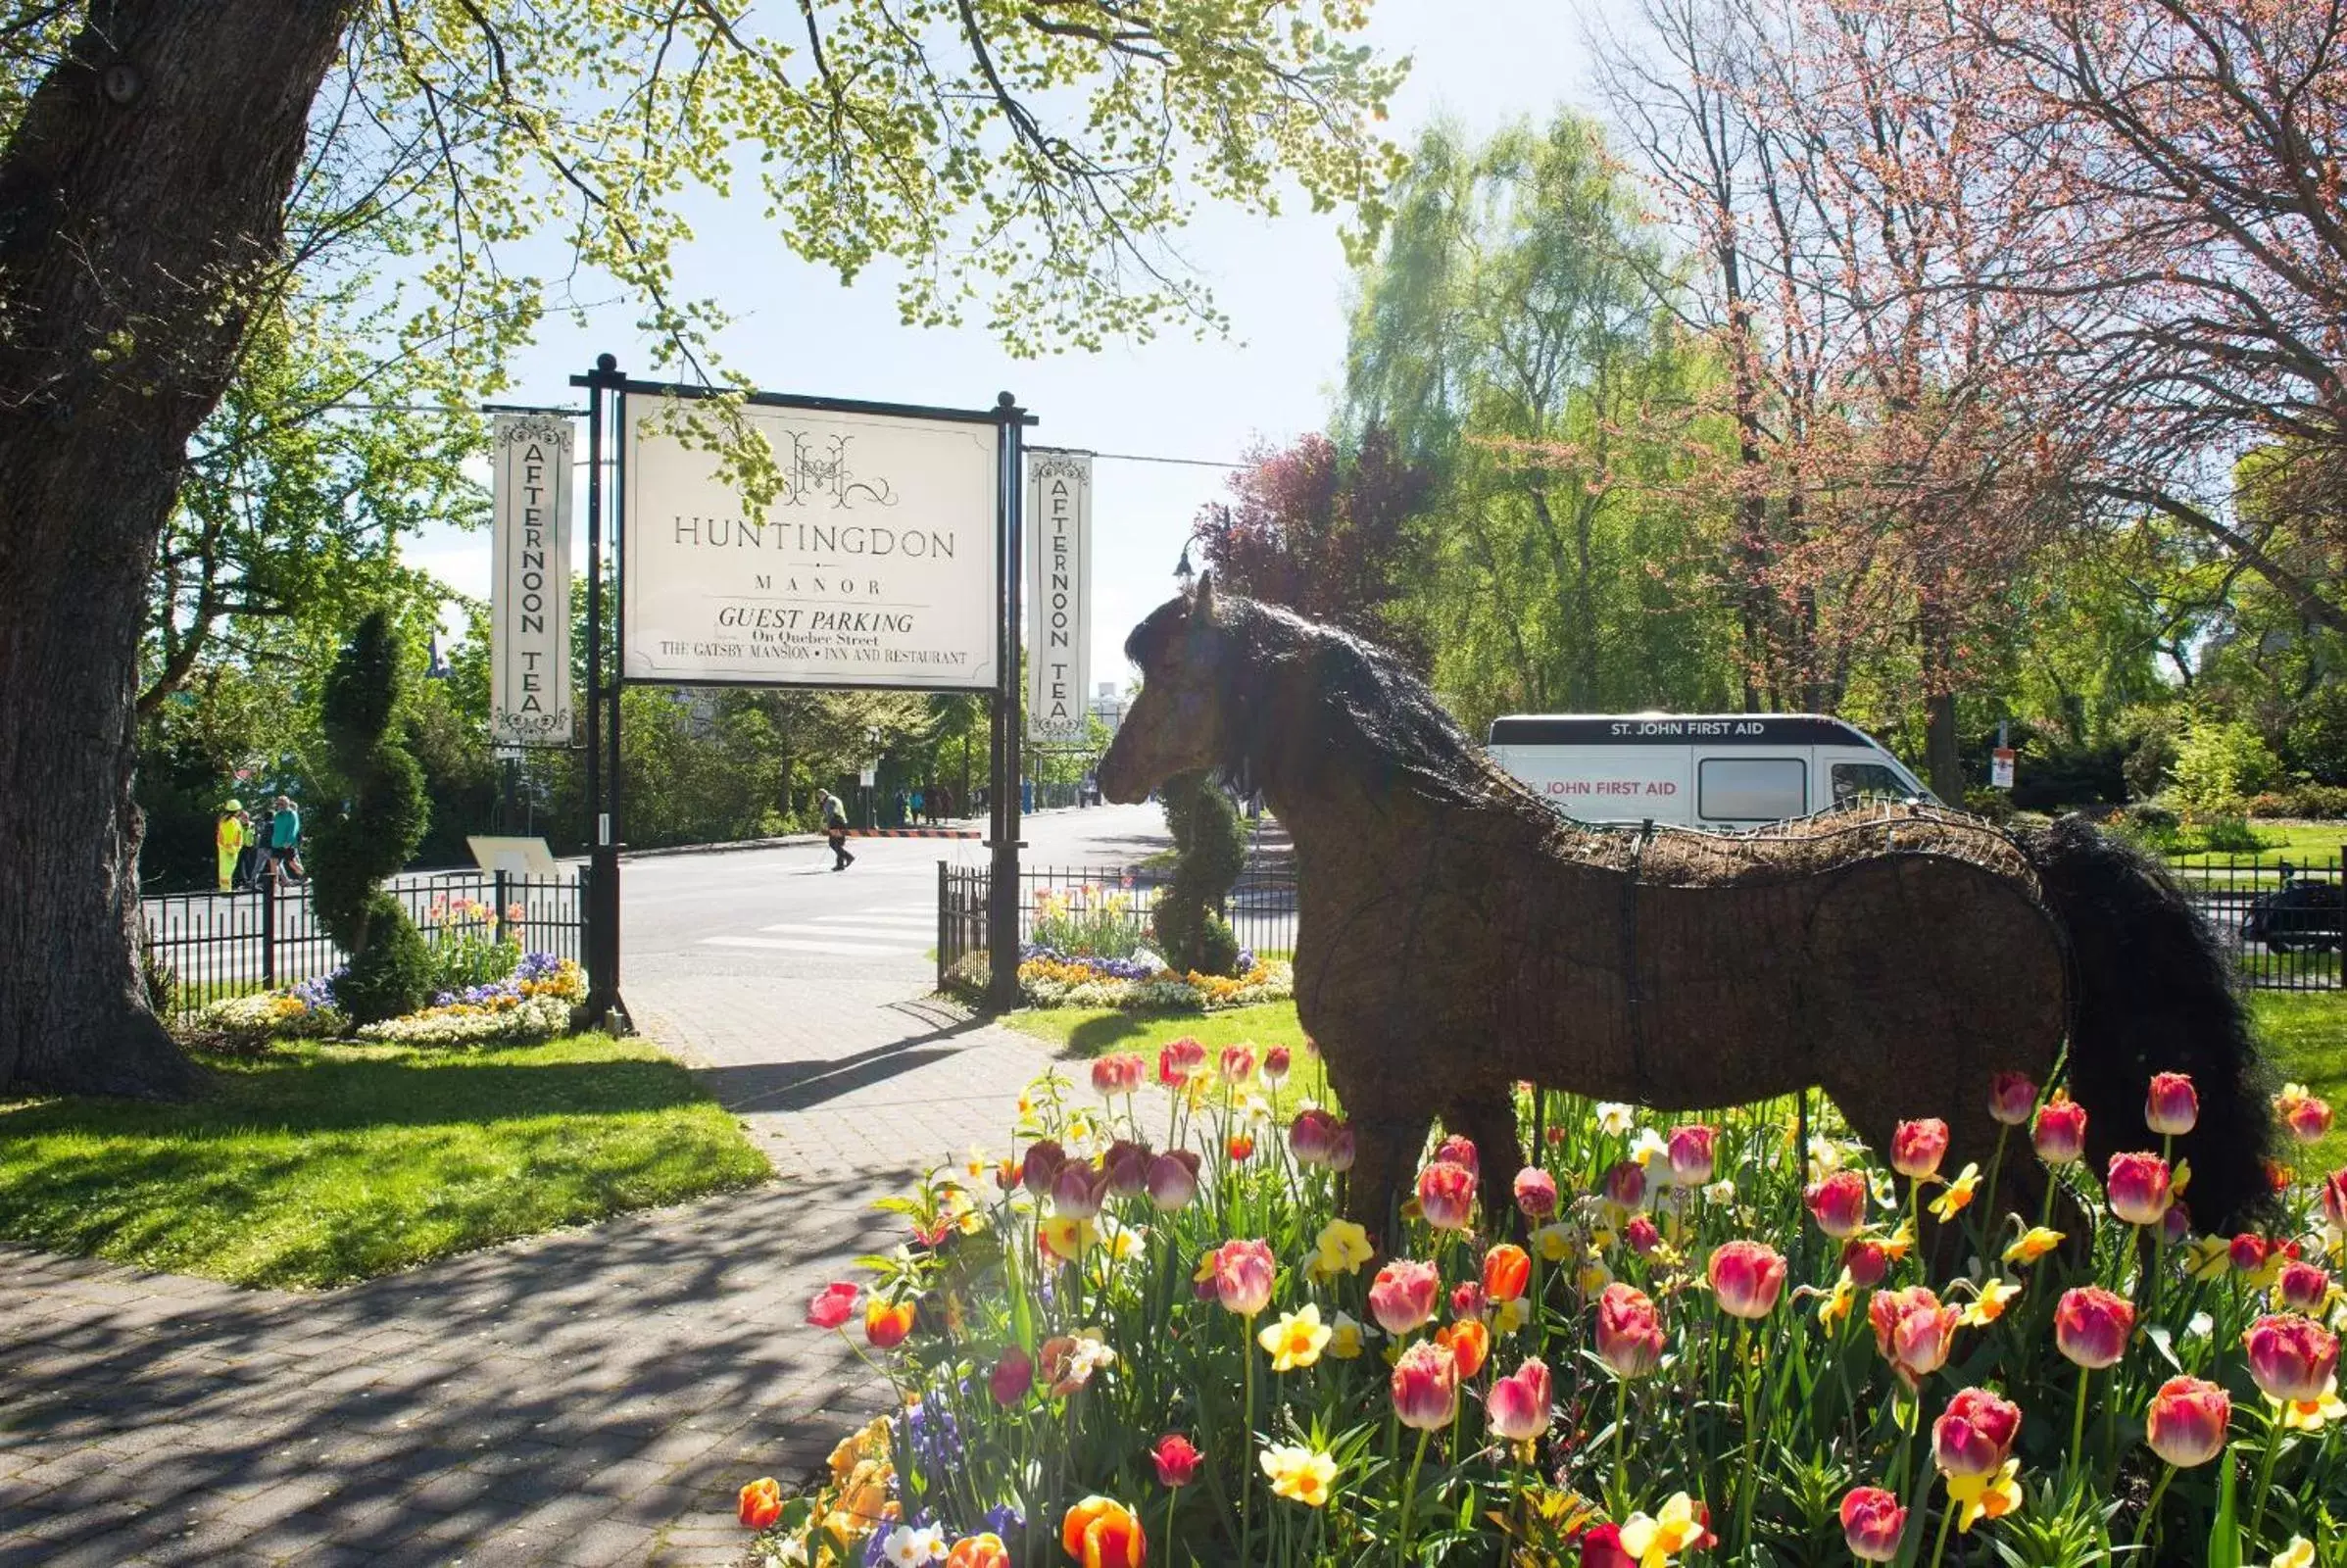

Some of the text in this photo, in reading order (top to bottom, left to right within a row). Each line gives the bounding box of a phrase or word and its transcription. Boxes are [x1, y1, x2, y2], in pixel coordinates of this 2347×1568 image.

[675, 516, 954, 558] HUNTINGDON
[521, 443, 545, 712] AFTERNOON TEA
[755, 575, 880, 595] MANOR
[1051, 479, 1069, 717] AFTERNOON TEA
[718, 607, 914, 633] GUEST PARKING
[752, 629, 878, 647] On Quebec Street
[660, 641, 967, 664] THE GATSBY MANSION INN AND RESTAURANT
[1610, 721, 1765, 735] ST. JOHN FIRST AID
[1546, 781, 1590, 795] JOHN
[1596, 781, 1640, 795] FIRST
[1645, 781, 1677, 796] AID
